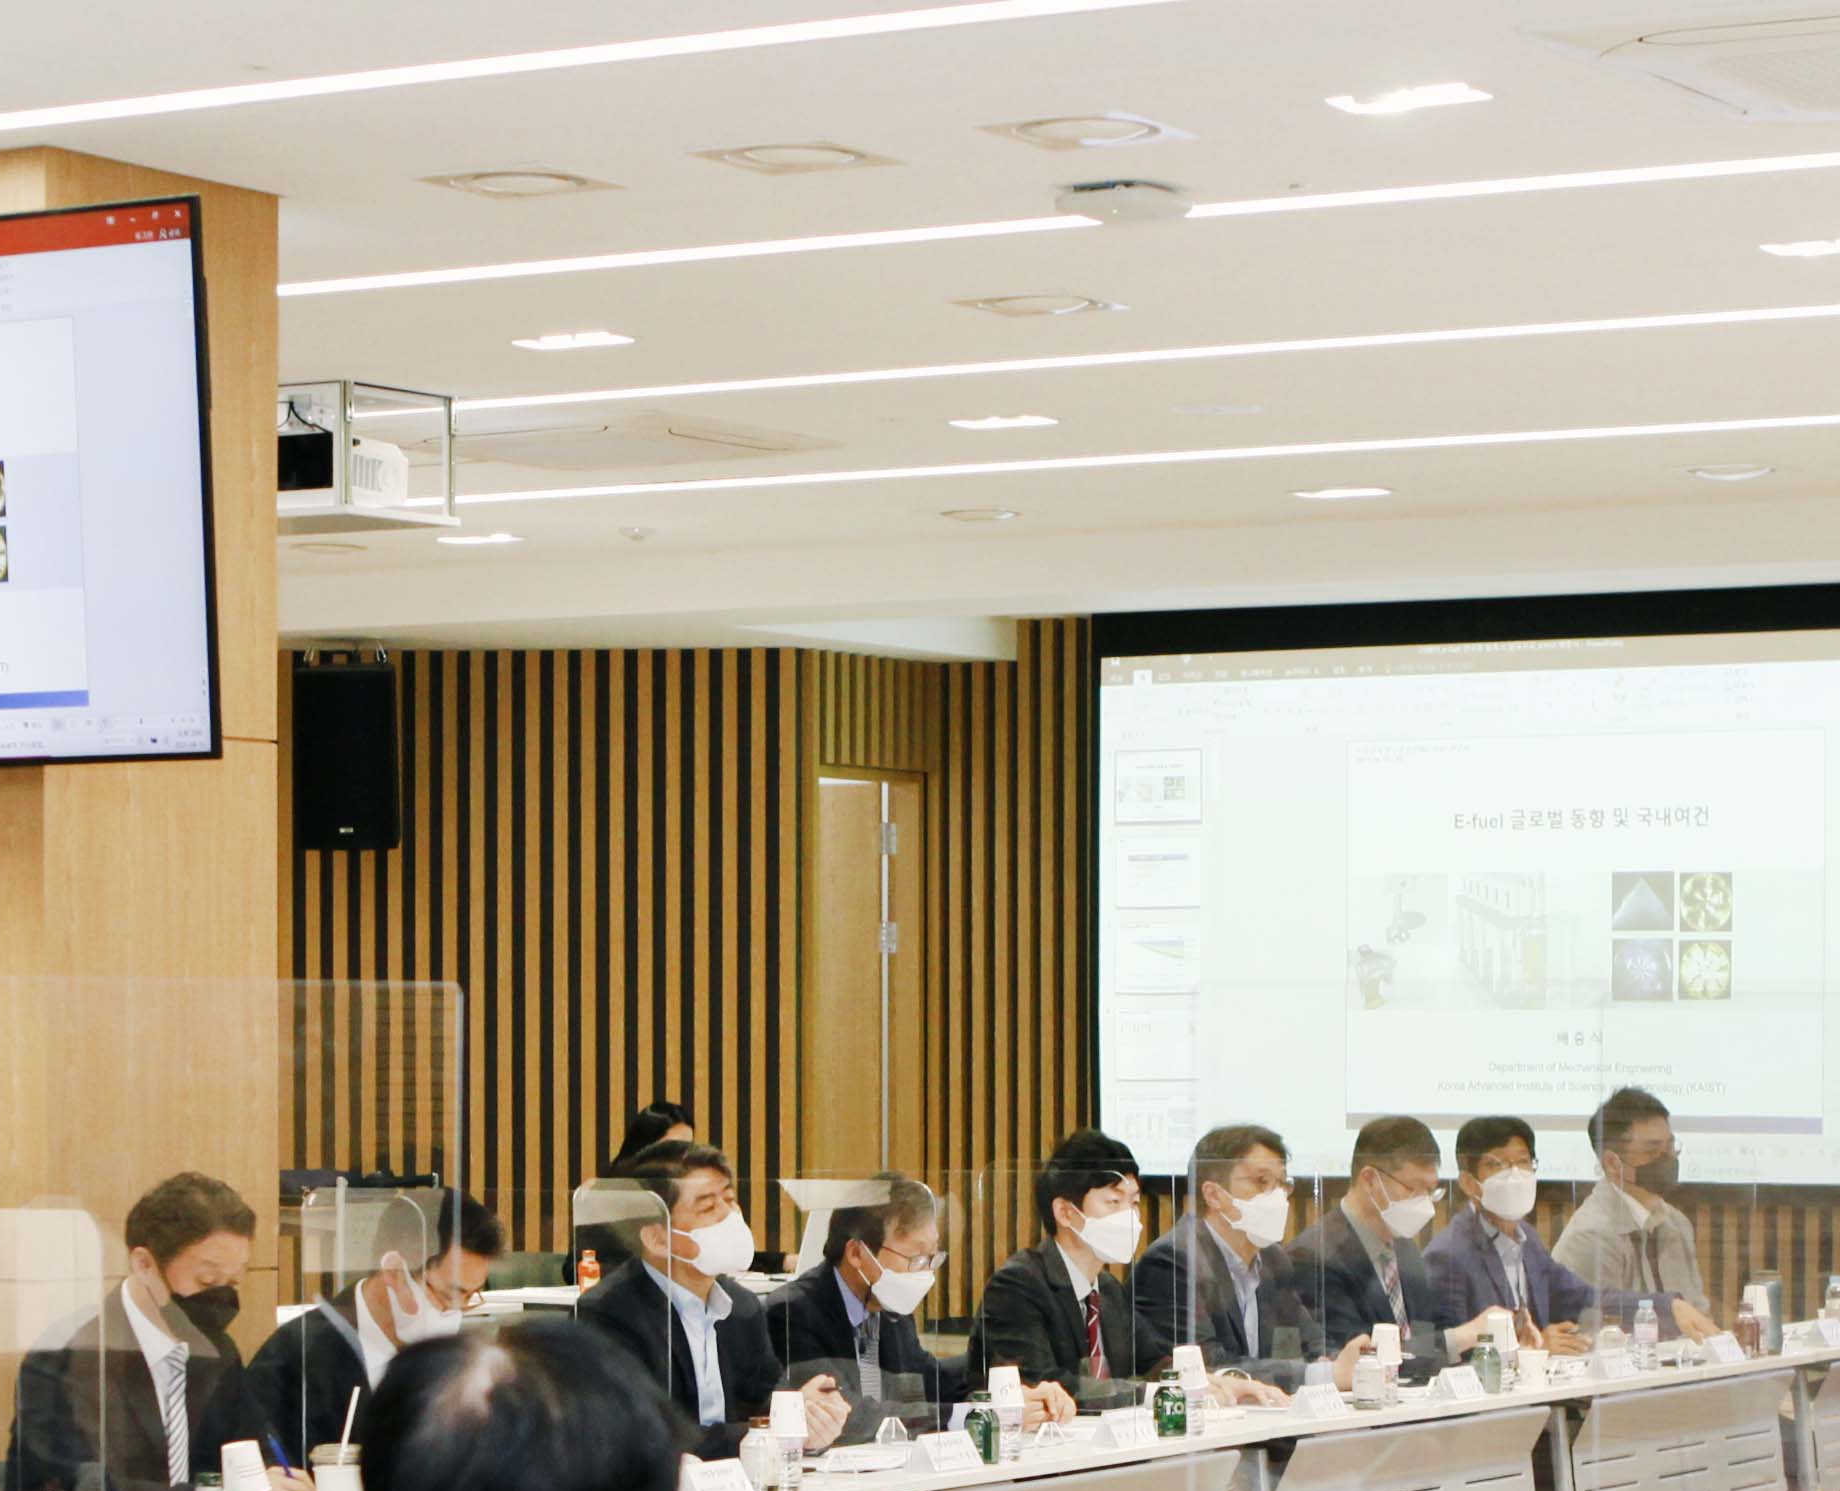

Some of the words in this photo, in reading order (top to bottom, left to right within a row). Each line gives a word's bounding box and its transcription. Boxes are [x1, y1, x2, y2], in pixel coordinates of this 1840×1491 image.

[1453, 811, 1504, 830] E-fuel
[1511, 808, 1562, 831] 글로벌
[1570, 807, 1605, 829] 동향
[1613, 806, 1629, 827] 및
[1637, 805, 1710, 828] 국내여건
